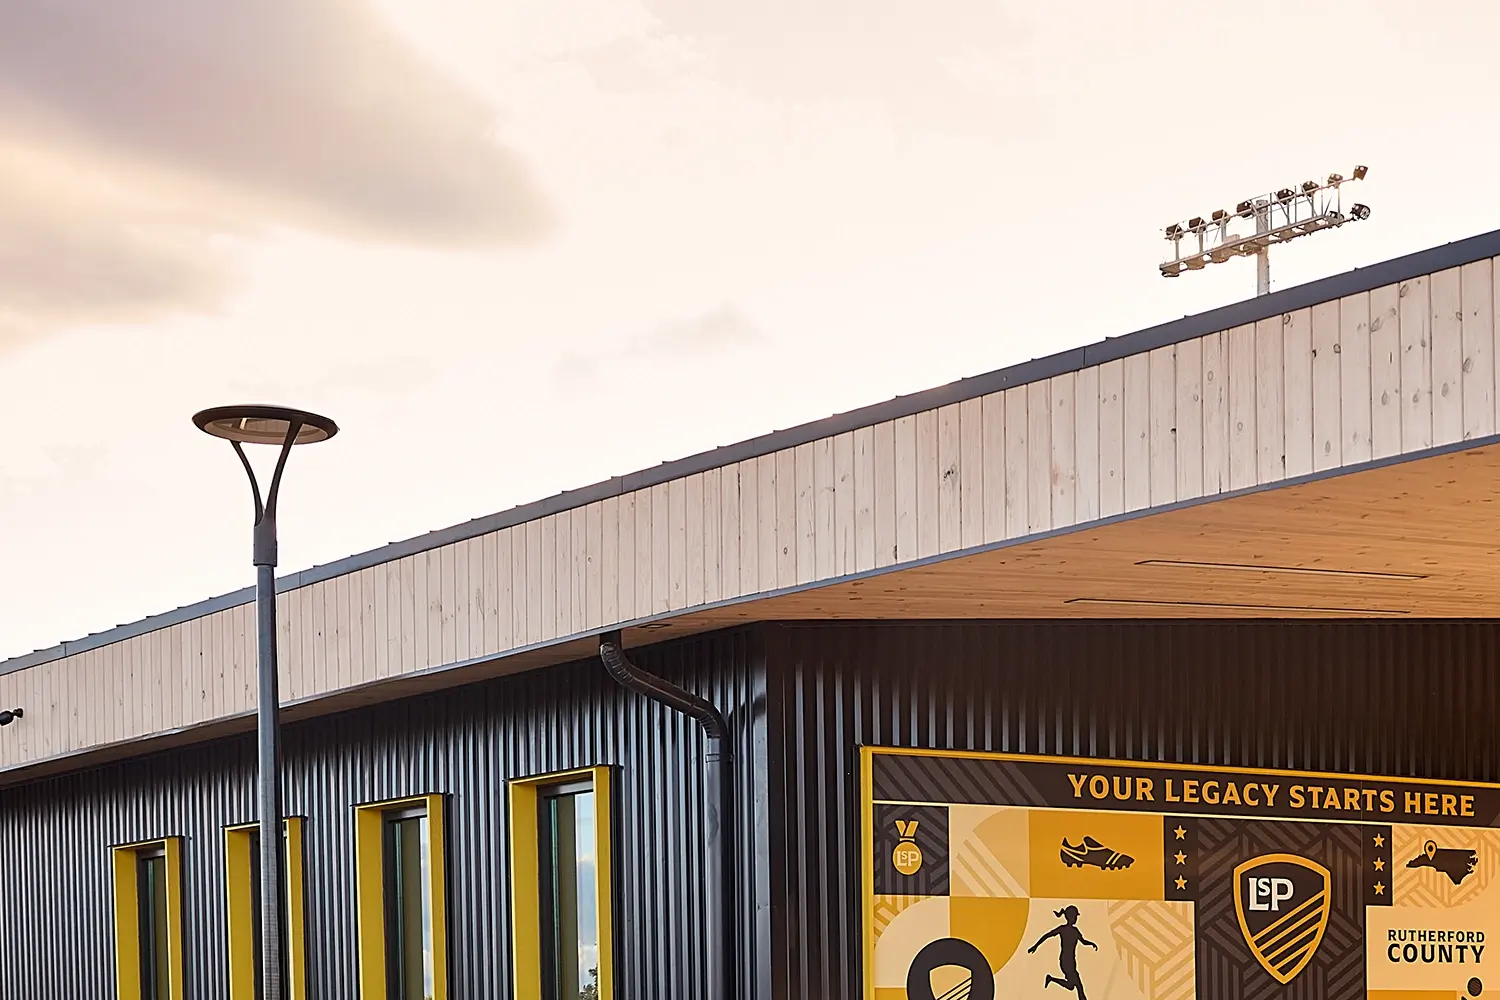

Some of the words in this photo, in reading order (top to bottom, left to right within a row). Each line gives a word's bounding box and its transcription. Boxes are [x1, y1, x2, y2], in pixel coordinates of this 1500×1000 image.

[1067, 774, 1154, 801] YOUR
[1165, 778, 1279, 806] LEGACY
[1289, 785, 1395, 812] STARTS
[1404, 792, 1475, 817] HERE
[1387, 929, 1485, 943] RUTHERFORD
[1387, 944, 1485, 964] COUNTY
